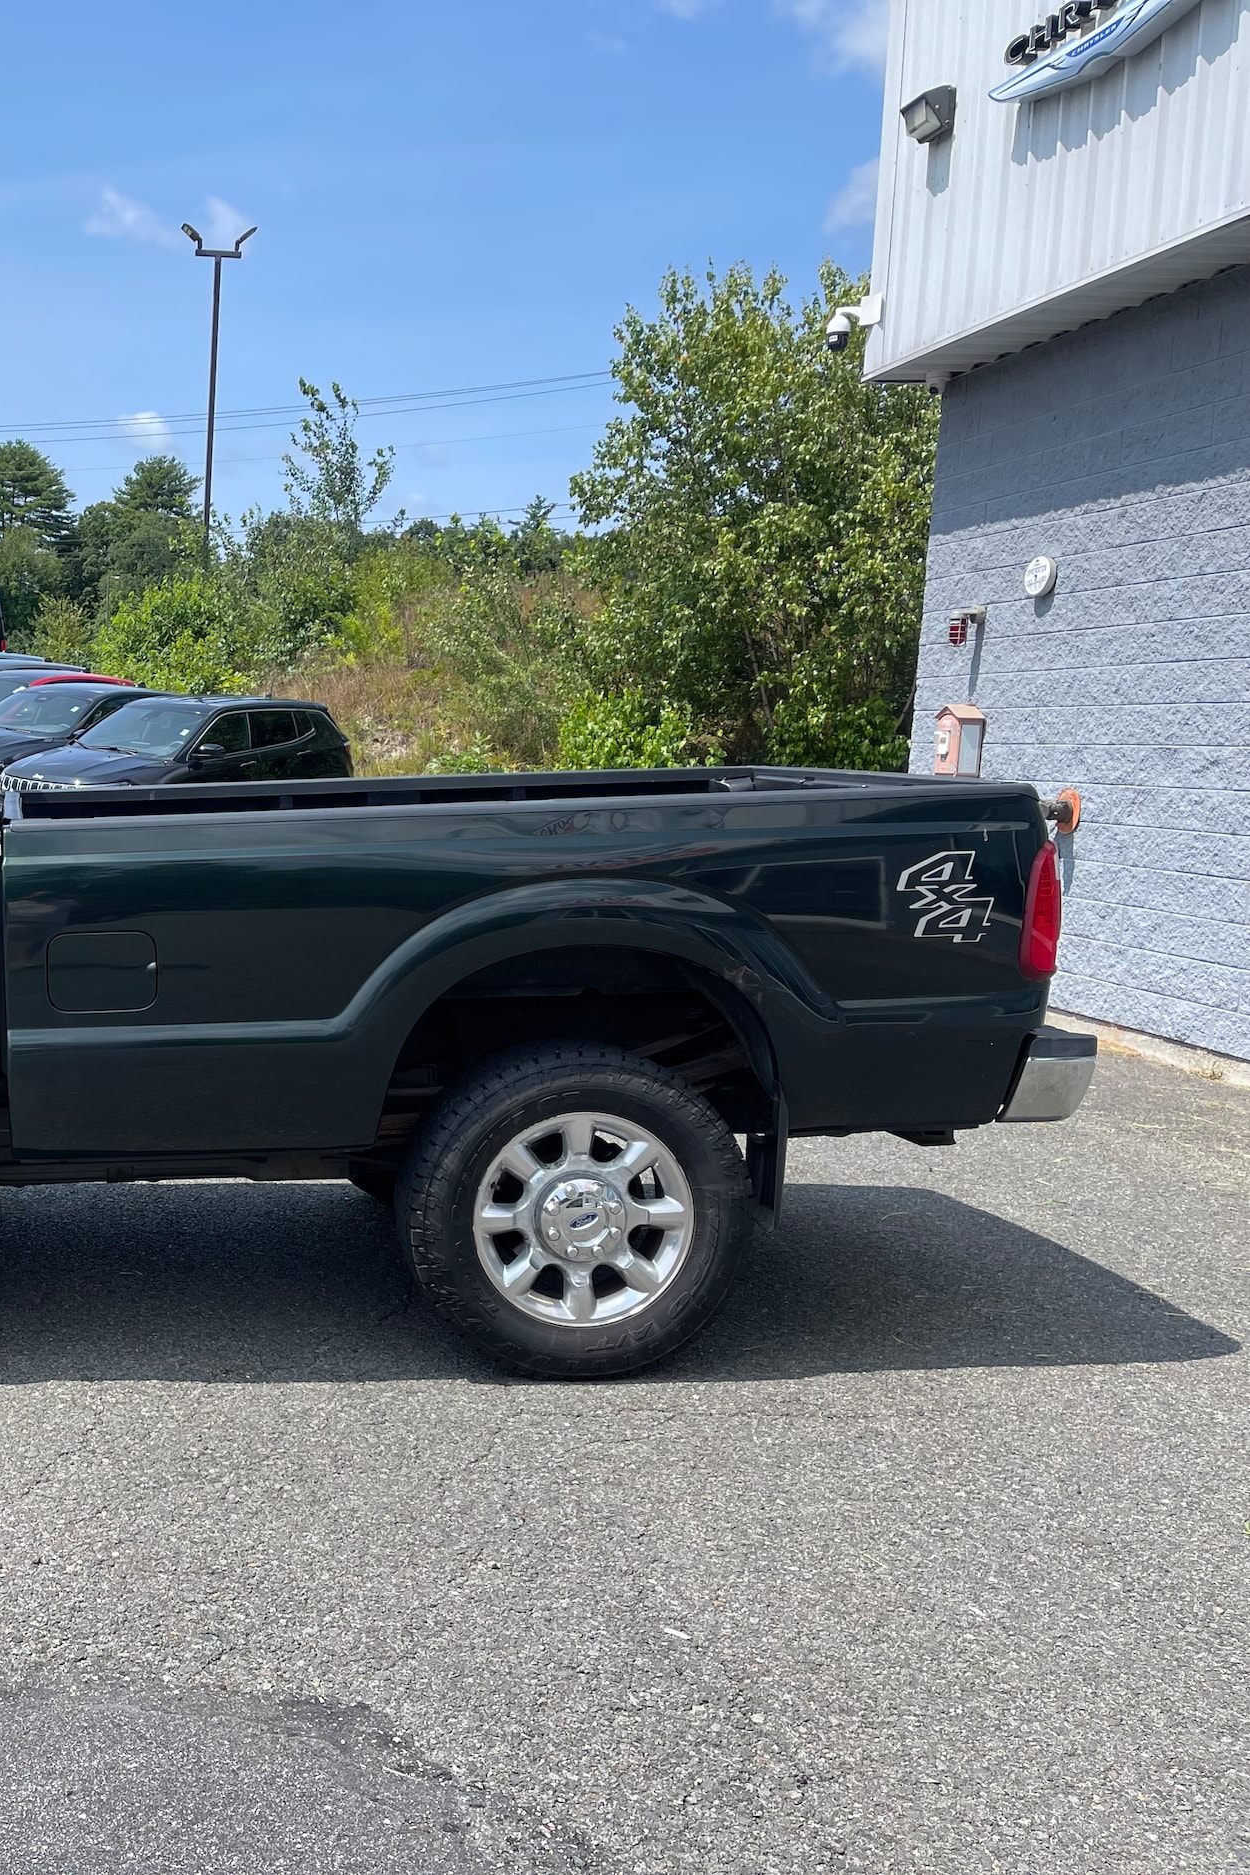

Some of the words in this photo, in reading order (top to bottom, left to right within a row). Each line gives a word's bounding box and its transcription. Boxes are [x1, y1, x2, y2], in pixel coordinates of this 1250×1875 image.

[1003, 0, 1114, 65] CHR
[1071, 23, 1117, 57] CHRYSLER
[570, 1212, 598, 1228] Ford
